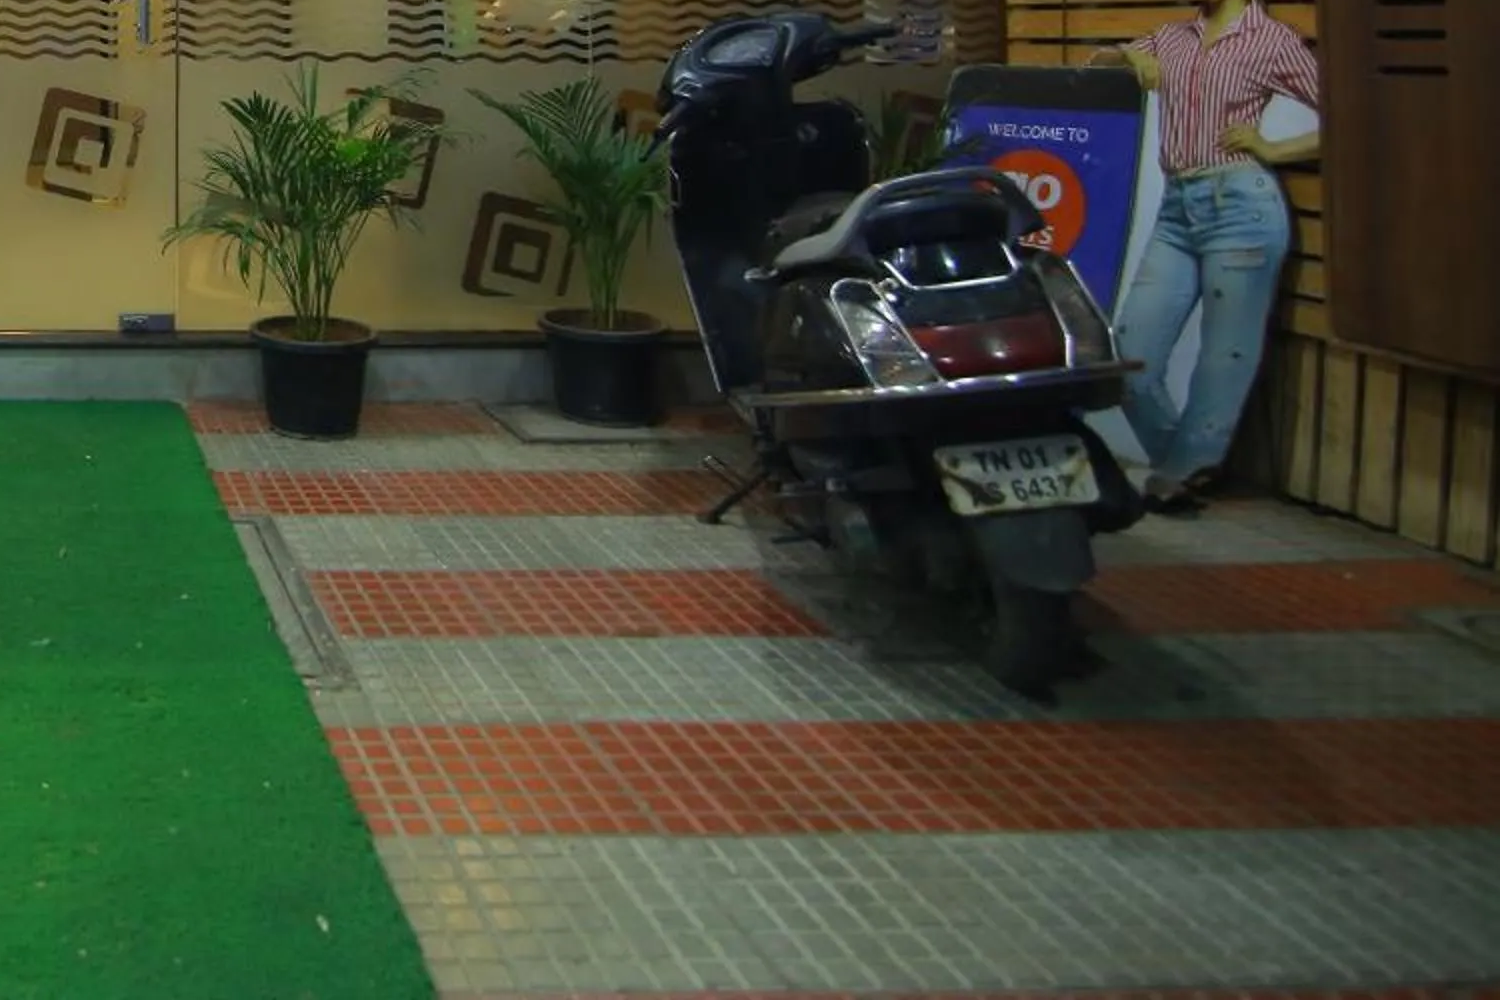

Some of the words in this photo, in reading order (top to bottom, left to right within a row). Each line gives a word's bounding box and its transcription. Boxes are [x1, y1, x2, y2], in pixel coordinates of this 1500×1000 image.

[988, 123, 1065, 141] WELCOME
[1068, 127, 1089, 143] TO
[972, 449, 1011, 472] TN
[1017, 445, 1049, 470] 01
[1011, 474, 1076, 502] 6437
